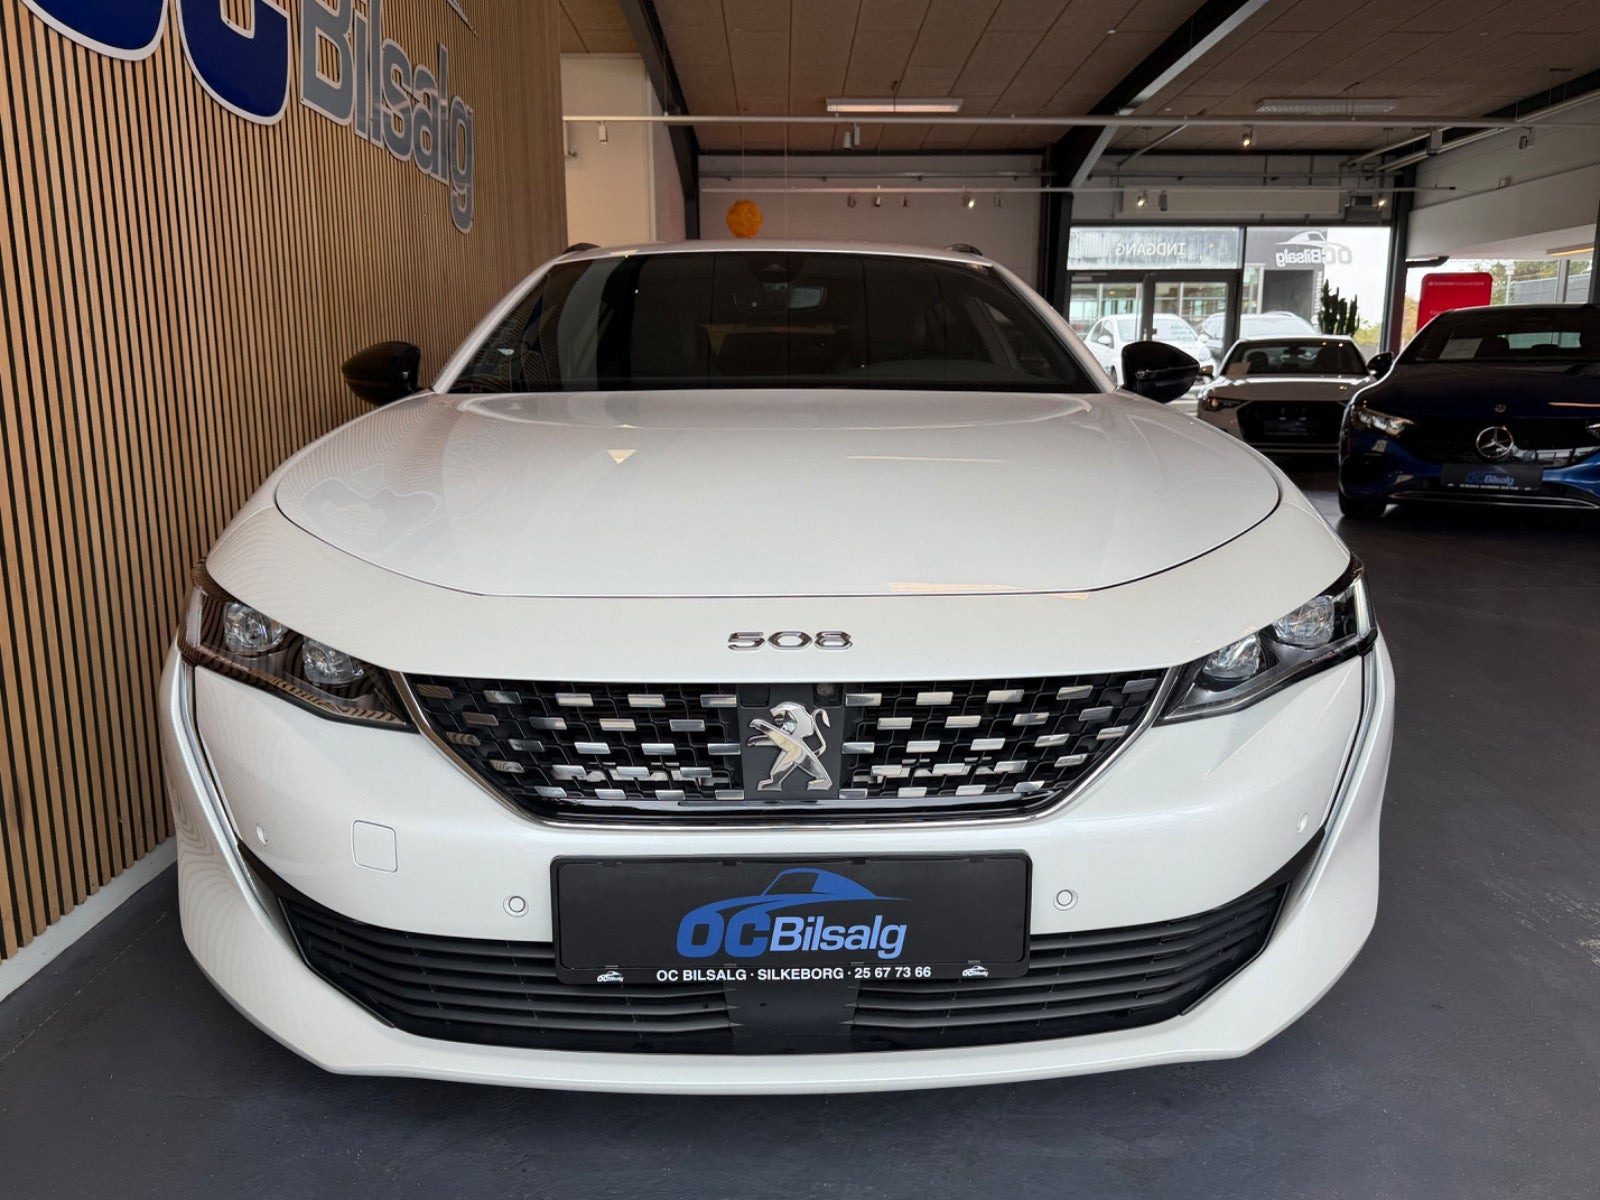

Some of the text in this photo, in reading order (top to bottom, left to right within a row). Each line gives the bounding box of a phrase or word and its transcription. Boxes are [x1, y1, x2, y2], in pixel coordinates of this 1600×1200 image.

[728, 631, 853, 650] 508
[656, 966, 932, 982] OC BILSALG SILKEBORG 25 67 73 66
